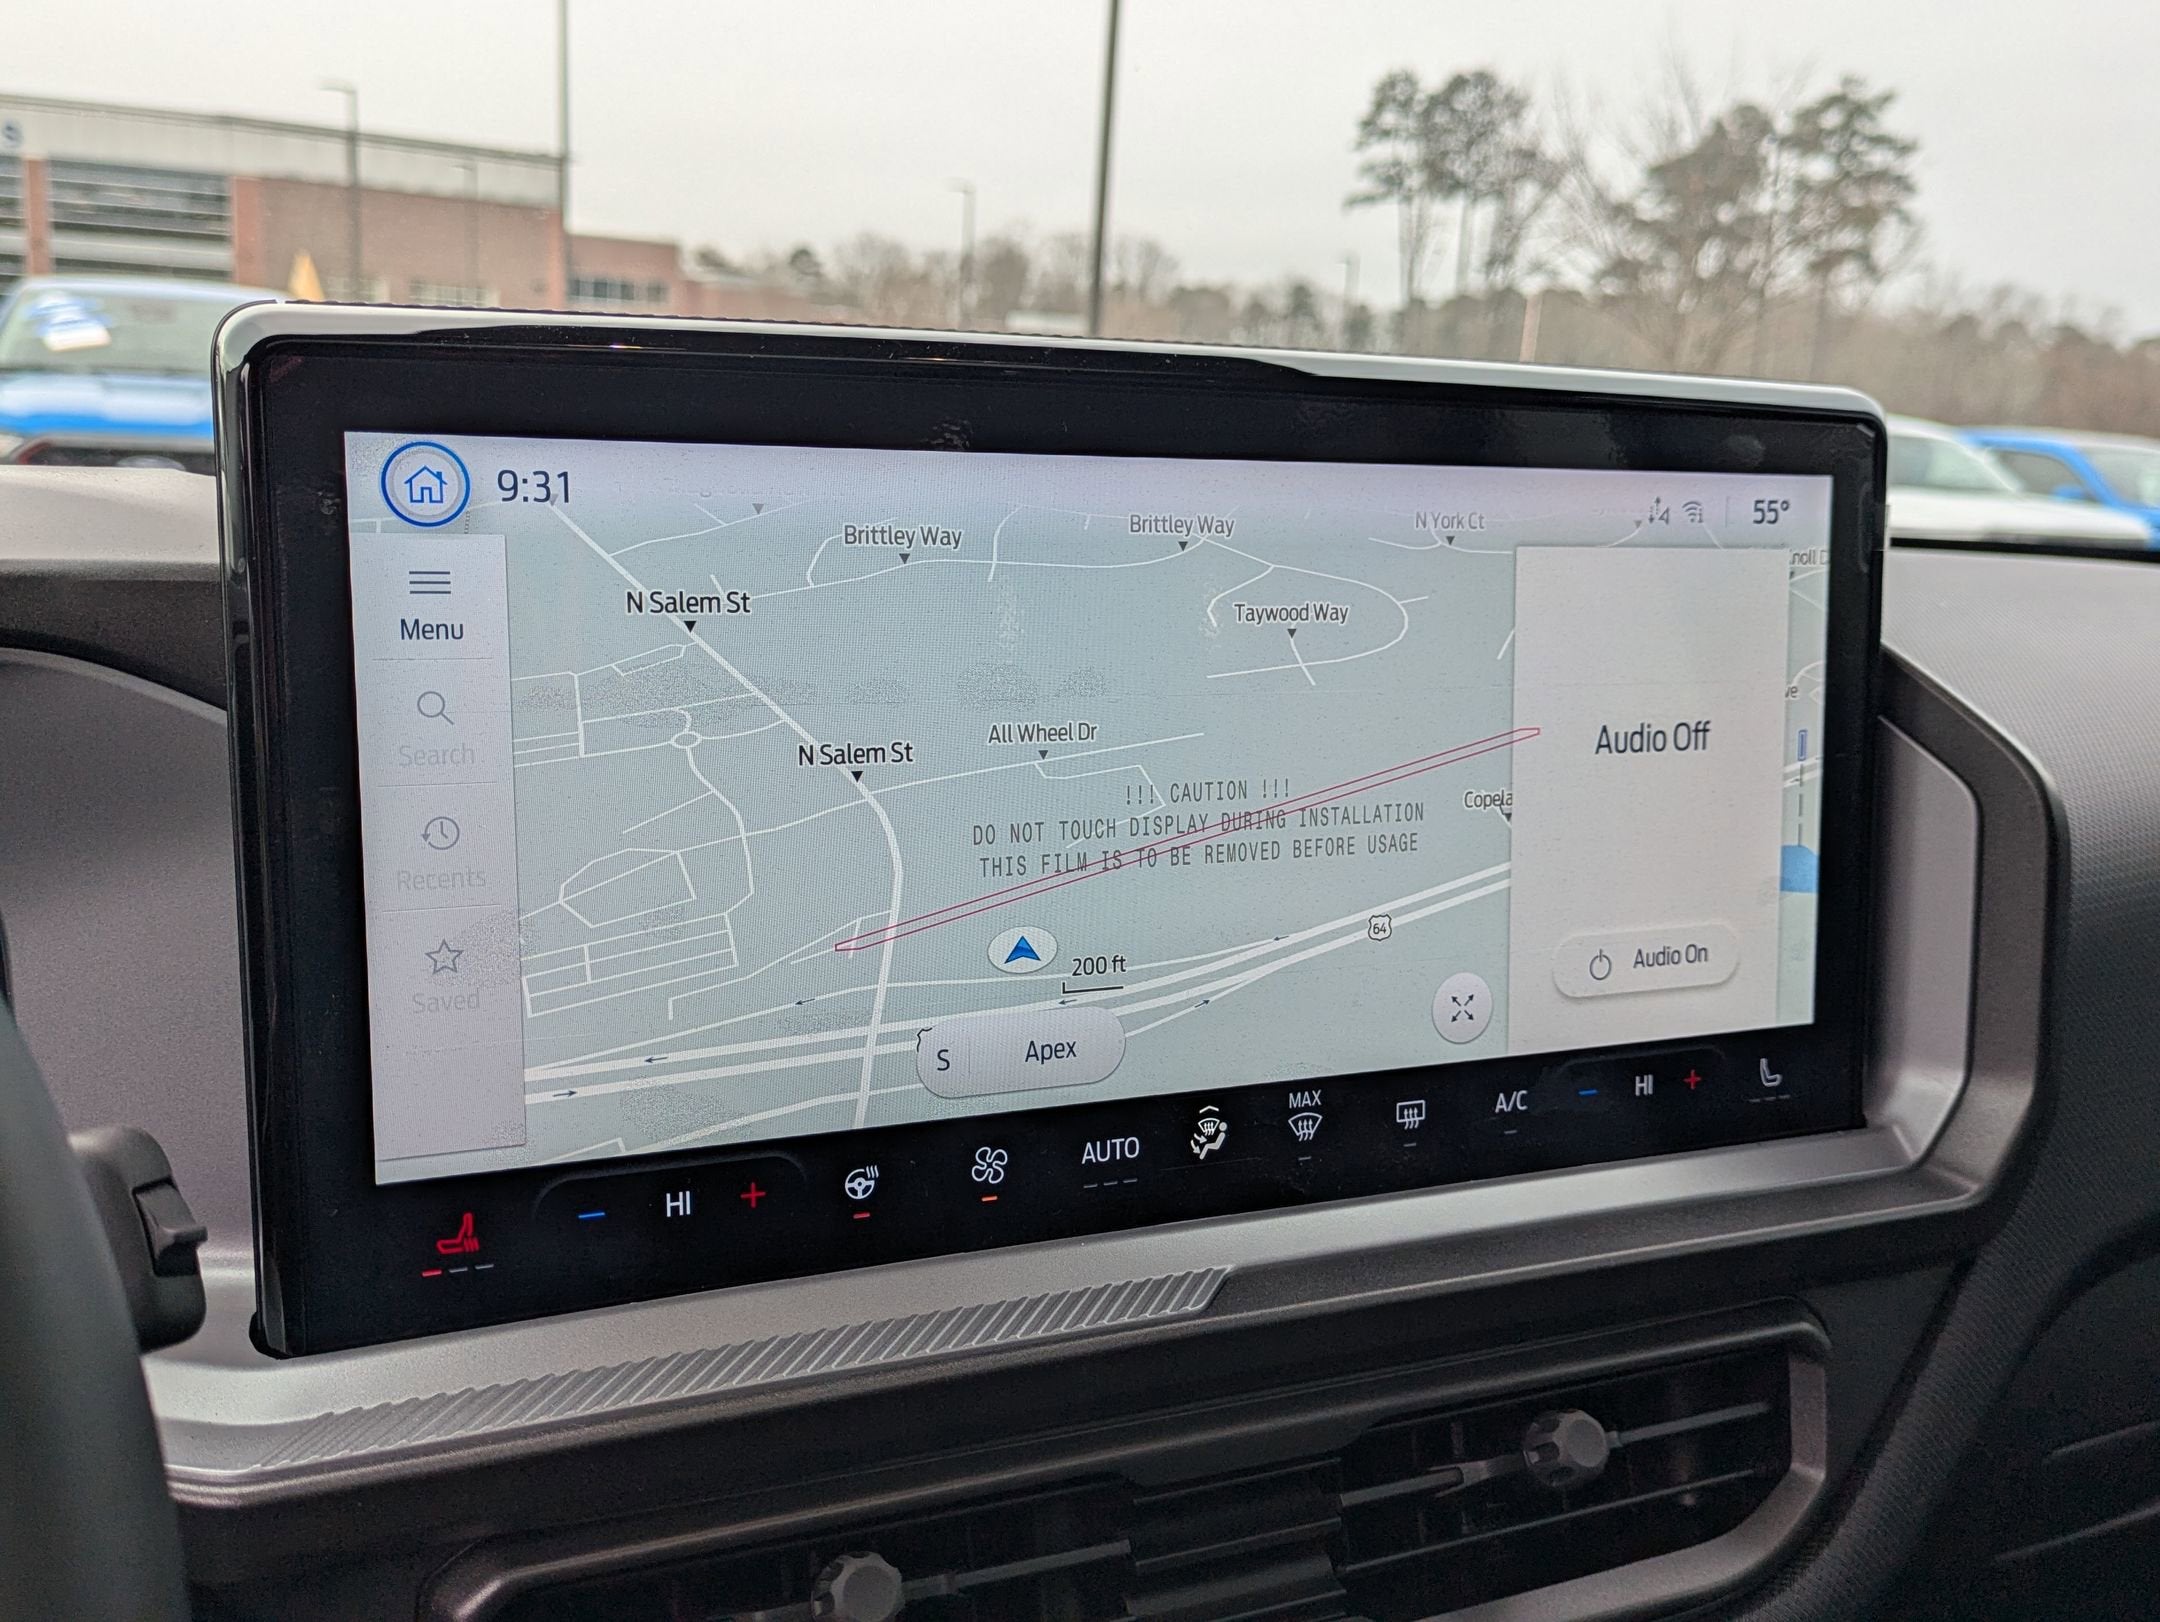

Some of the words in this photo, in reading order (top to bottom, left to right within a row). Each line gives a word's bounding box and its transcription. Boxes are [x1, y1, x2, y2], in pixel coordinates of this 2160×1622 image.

[497, 470, 571, 503] 9:31
[1415, 512, 1427, 529] N
[1430, 512, 1464, 529] York
[1467, 512, 1485, 529] Ct
[1753, 499, 1790, 525] 55°
[845, 525, 914, 549] Brittley
[920, 527, 962, 549] Way
[1129, 514, 1190, 537] Brittley
[1192, 515, 1234, 537] Way
[626, 592, 643, 613] N
[650, 591, 720, 613] Salem
[725, 591, 751, 613] St
[1234, 603, 1309, 623] Taywood
[1313, 604, 1348, 624] Way
[400, 619, 464, 641] Menu
[988, 726, 1014, 743] All
[1018, 724, 1073, 743] Wheel
[1079, 723, 1098, 741] Dr
[1595, 722, 1667, 754] Audio
[1673, 721, 1711, 750] Off
[399, 744, 475, 767] Search
[799, 745, 814, 766] N
[820, 743, 886, 765] Salem
[889, 742, 913, 763] St
[1127, 784, 1154, 805] !!!
[1170, 780, 1248, 802] CAUTION
[1262, 778, 1290, 798] !!!
[973, 824, 995, 845] DO
[1010, 821, 1044, 843] NOT
[1059, 818, 1116, 840] TOUCH
[1130, 813, 1209, 837] DISPLAY
[1221, 810, 1287, 831] DURING
[1300, 803, 1425, 827] INSTALLATION
[980, 855, 1027, 878] THIS
[1041, 851, 1088, 873] FILM
[1101, 849, 1122, 871] IS
[1136, 848, 1158, 869] TO
[1170, 845, 1191, 866] BE
[1204, 840, 1280, 865] REMOVED
[1293, 837, 1356, 859] BEFORE
[1367, 833, 1418, 853] USAGE
[397, 868, 487, 891] Recents
[1372, 922, 1387, 936] 64
[1072, 958, 1109, 976] 200
[1113, 956, 1126, 974] ft
[1633, 948, 1681, 969] Audio
[1685, 944, 1708, 964] On
[412, 990, 480, 1015] Saved
[936, 1048, 950, 1071] S
[1025, 1039, 1077, 1063] Apex
[1635, 1074, 1653, 1096] HI
[1288, 1089, 1322, 1109] MAX
[1495, 1091, 1528, 1113] A/C
[1081, 1136, 1140, 1164] AUTO
[665, 1191, 691, 1218] HI
